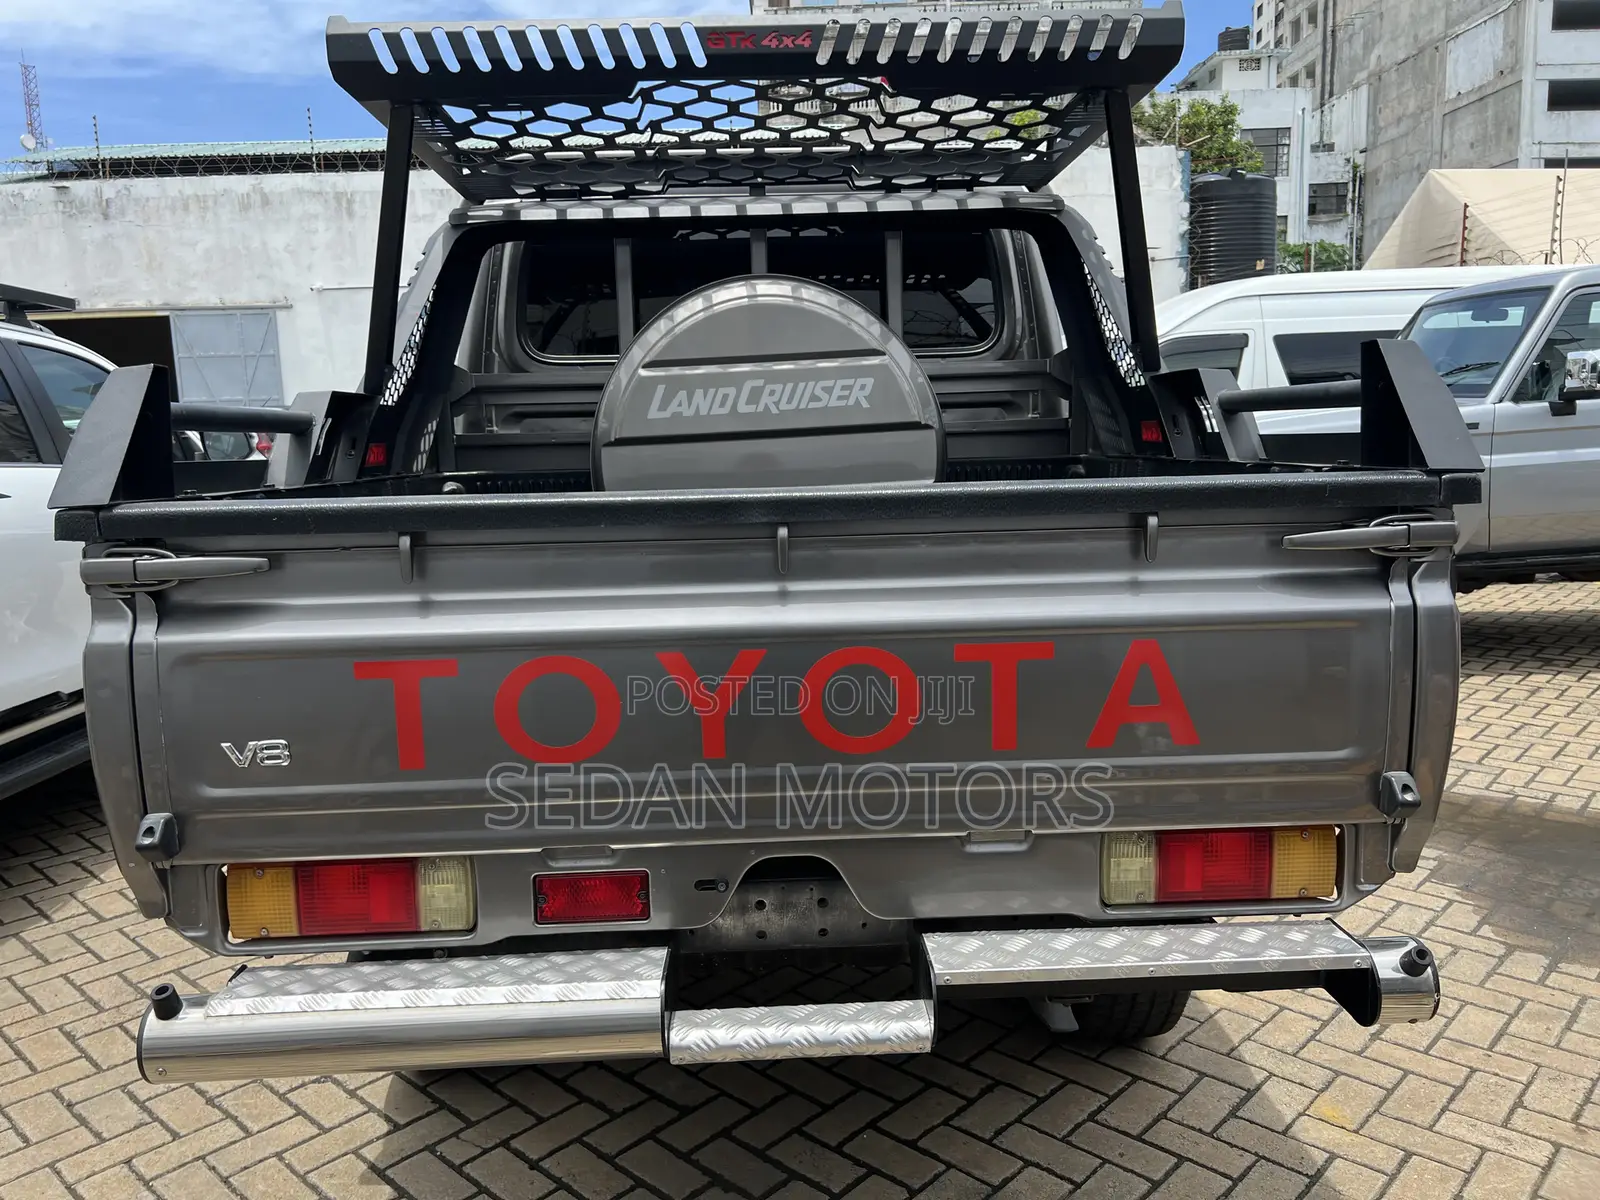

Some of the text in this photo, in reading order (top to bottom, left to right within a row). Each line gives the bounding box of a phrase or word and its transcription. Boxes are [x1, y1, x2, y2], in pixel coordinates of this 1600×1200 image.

[760, 30, 813, 49] 4x4
[354, 639, 1198, 771] TOYOTA
[220, 739, 291, 768] V8
